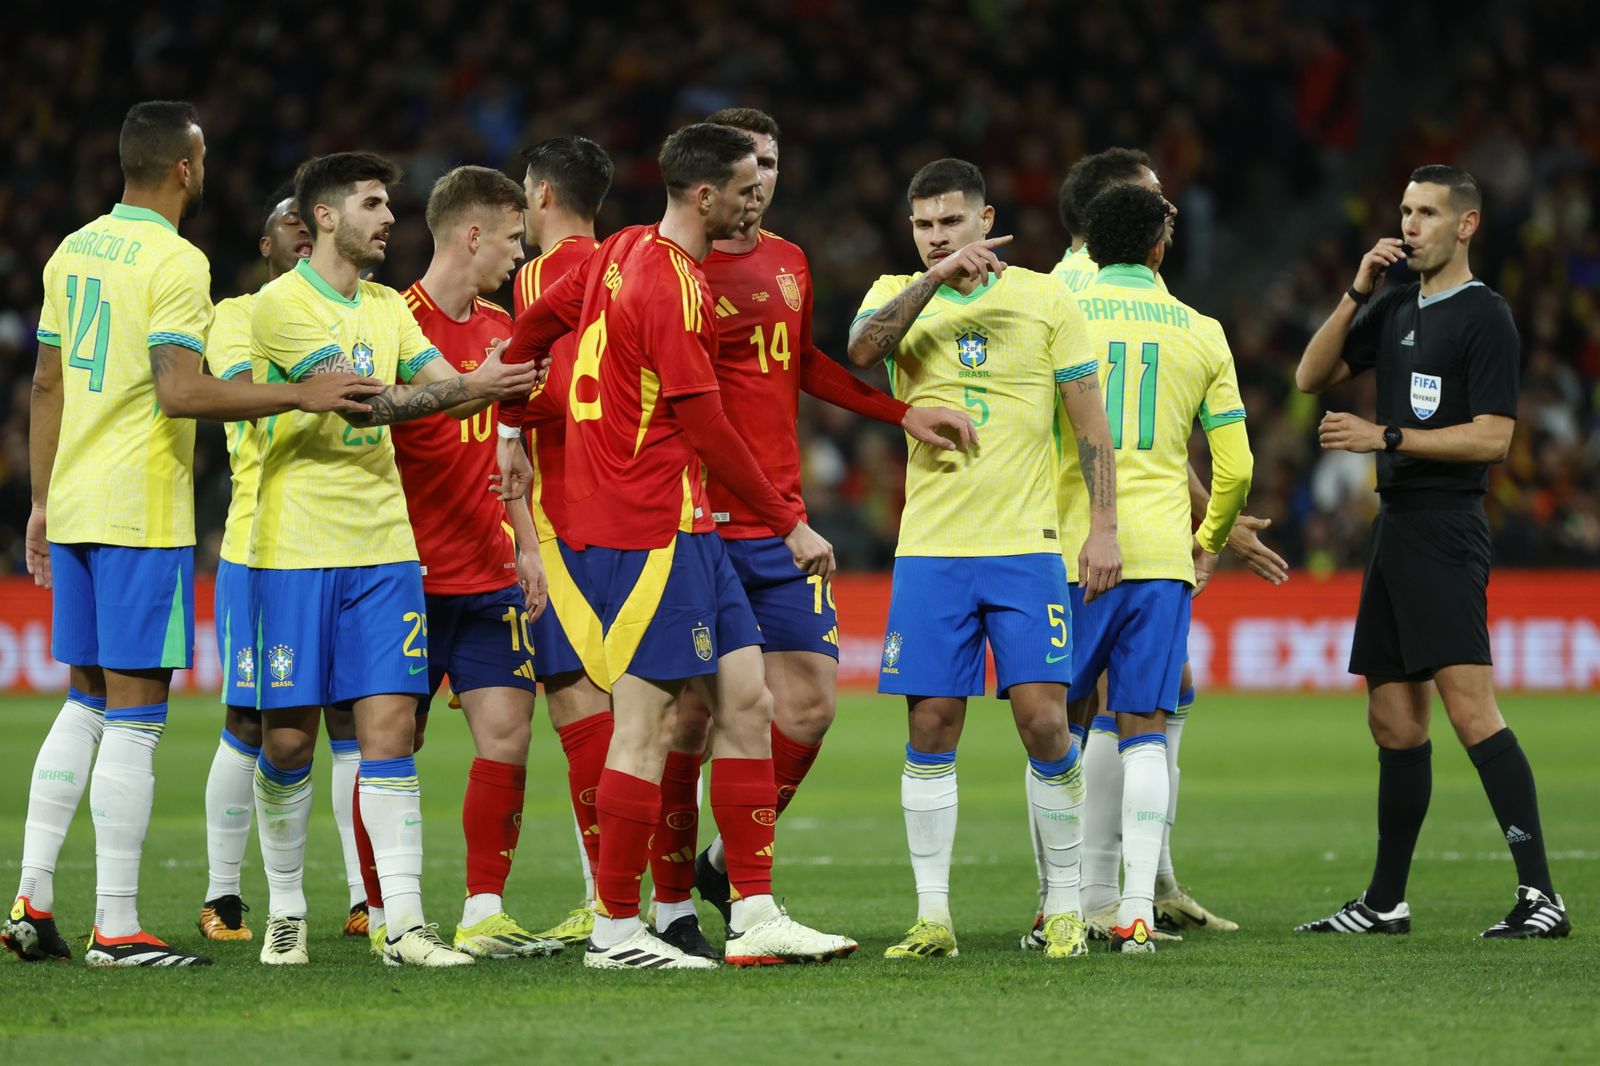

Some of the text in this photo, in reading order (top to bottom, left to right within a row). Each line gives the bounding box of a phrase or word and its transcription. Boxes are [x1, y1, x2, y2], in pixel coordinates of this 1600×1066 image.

[61, 228, 142, 266] ABRÍCIO B.
[1078, 297, 1190, 329] RAPHINHA
[66, 274, 111, 393] 14
[750, 321, 791, 373] 14
[958, 370, 992, 378] BRASIL
[1413, 376, 1437, 390] FIFA
[965, 384, 990, 428] 5
[1106, 341, 1159, 450] 11
[1412, 392, 1437, 402] REFEREE
[1047, 603, 1067, 648] 5
[38, 769, 77, 785] BRASIL
